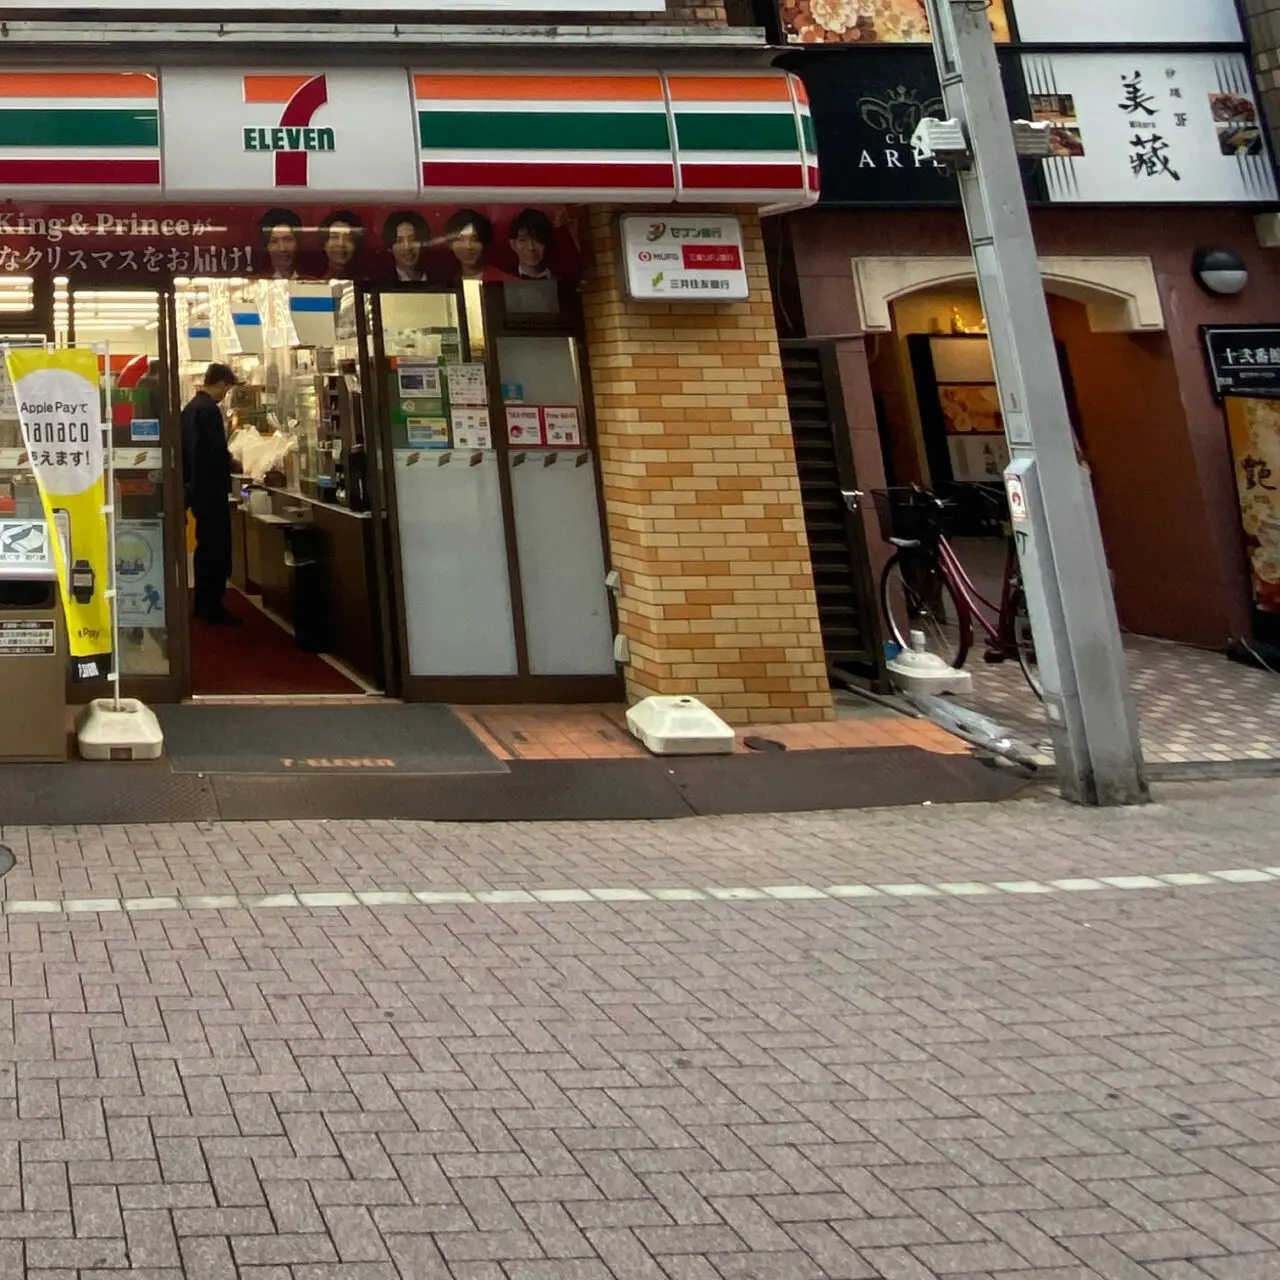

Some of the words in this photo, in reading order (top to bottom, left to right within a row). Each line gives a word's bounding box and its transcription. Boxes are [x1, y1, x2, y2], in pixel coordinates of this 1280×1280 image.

[670, 226, 723, 239] セブン銀行
[653, 253, 680, 261] MUFG
[670, 279, 730, 290] 三井住友銀行
[21, 402, 53, 414] Apple
